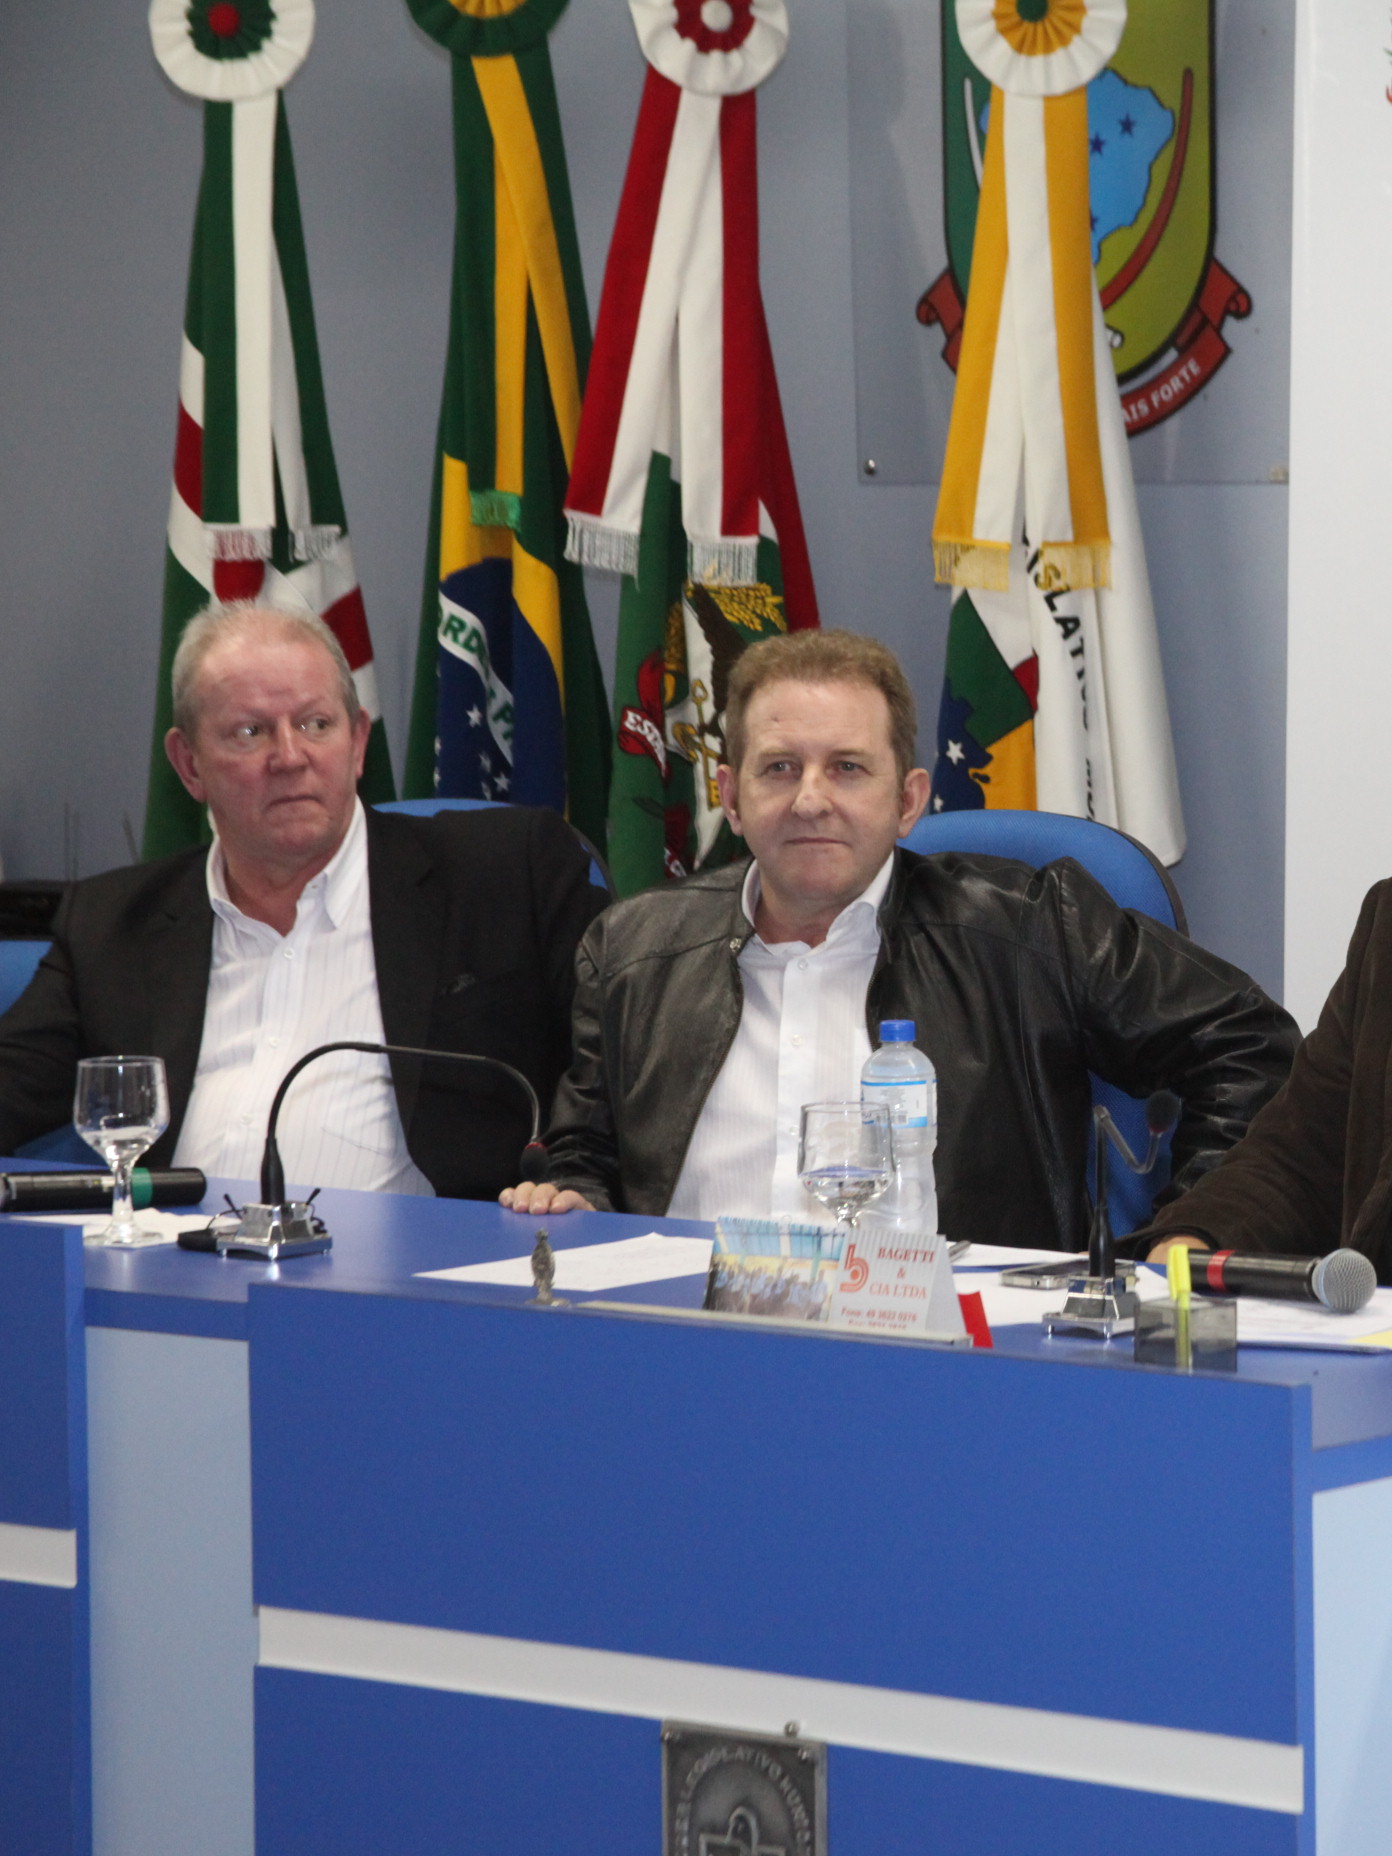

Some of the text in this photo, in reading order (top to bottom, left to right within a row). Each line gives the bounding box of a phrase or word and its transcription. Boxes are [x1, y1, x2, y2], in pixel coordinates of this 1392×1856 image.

[1150, 357, 1202, 409] FORTE
[877, 1246, 936, 1264] BAGETTI
[896, 1267, 907, 1280] &
[868, 1281, 928, 1300] CIA LTDA
